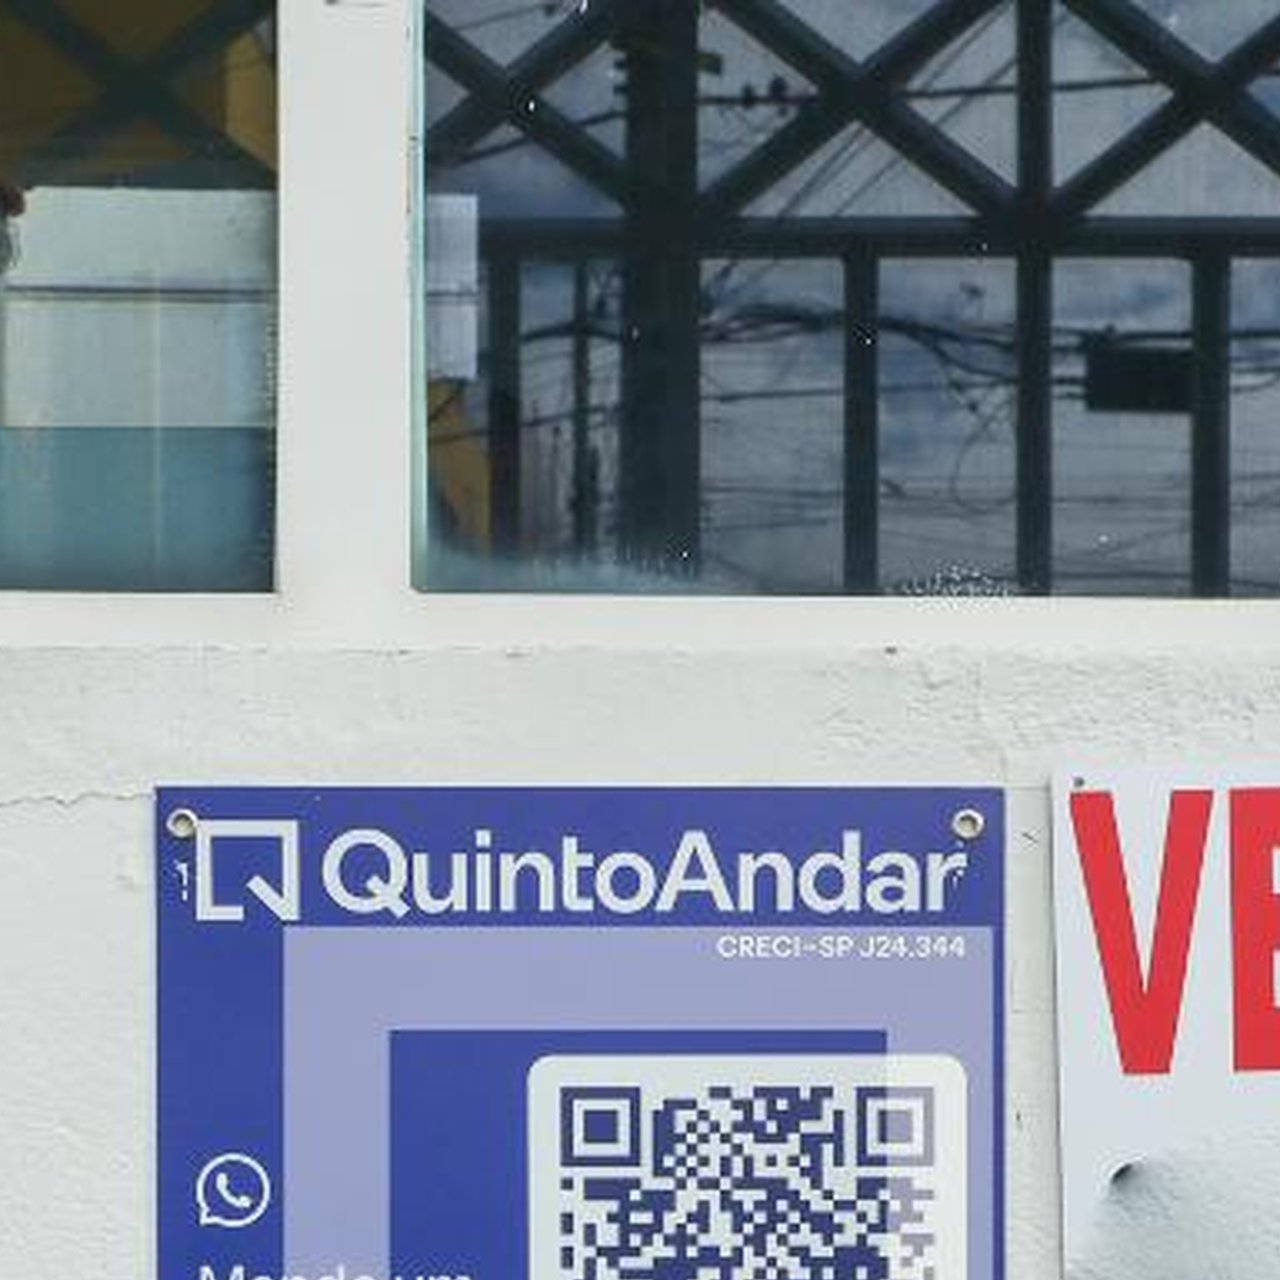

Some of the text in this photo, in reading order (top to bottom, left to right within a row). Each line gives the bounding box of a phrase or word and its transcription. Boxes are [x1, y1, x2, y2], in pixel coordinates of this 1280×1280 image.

[322, 830, 968, 917] QuintoAndar
[716, 934, 966, 959] CRECI-SP J24.344
